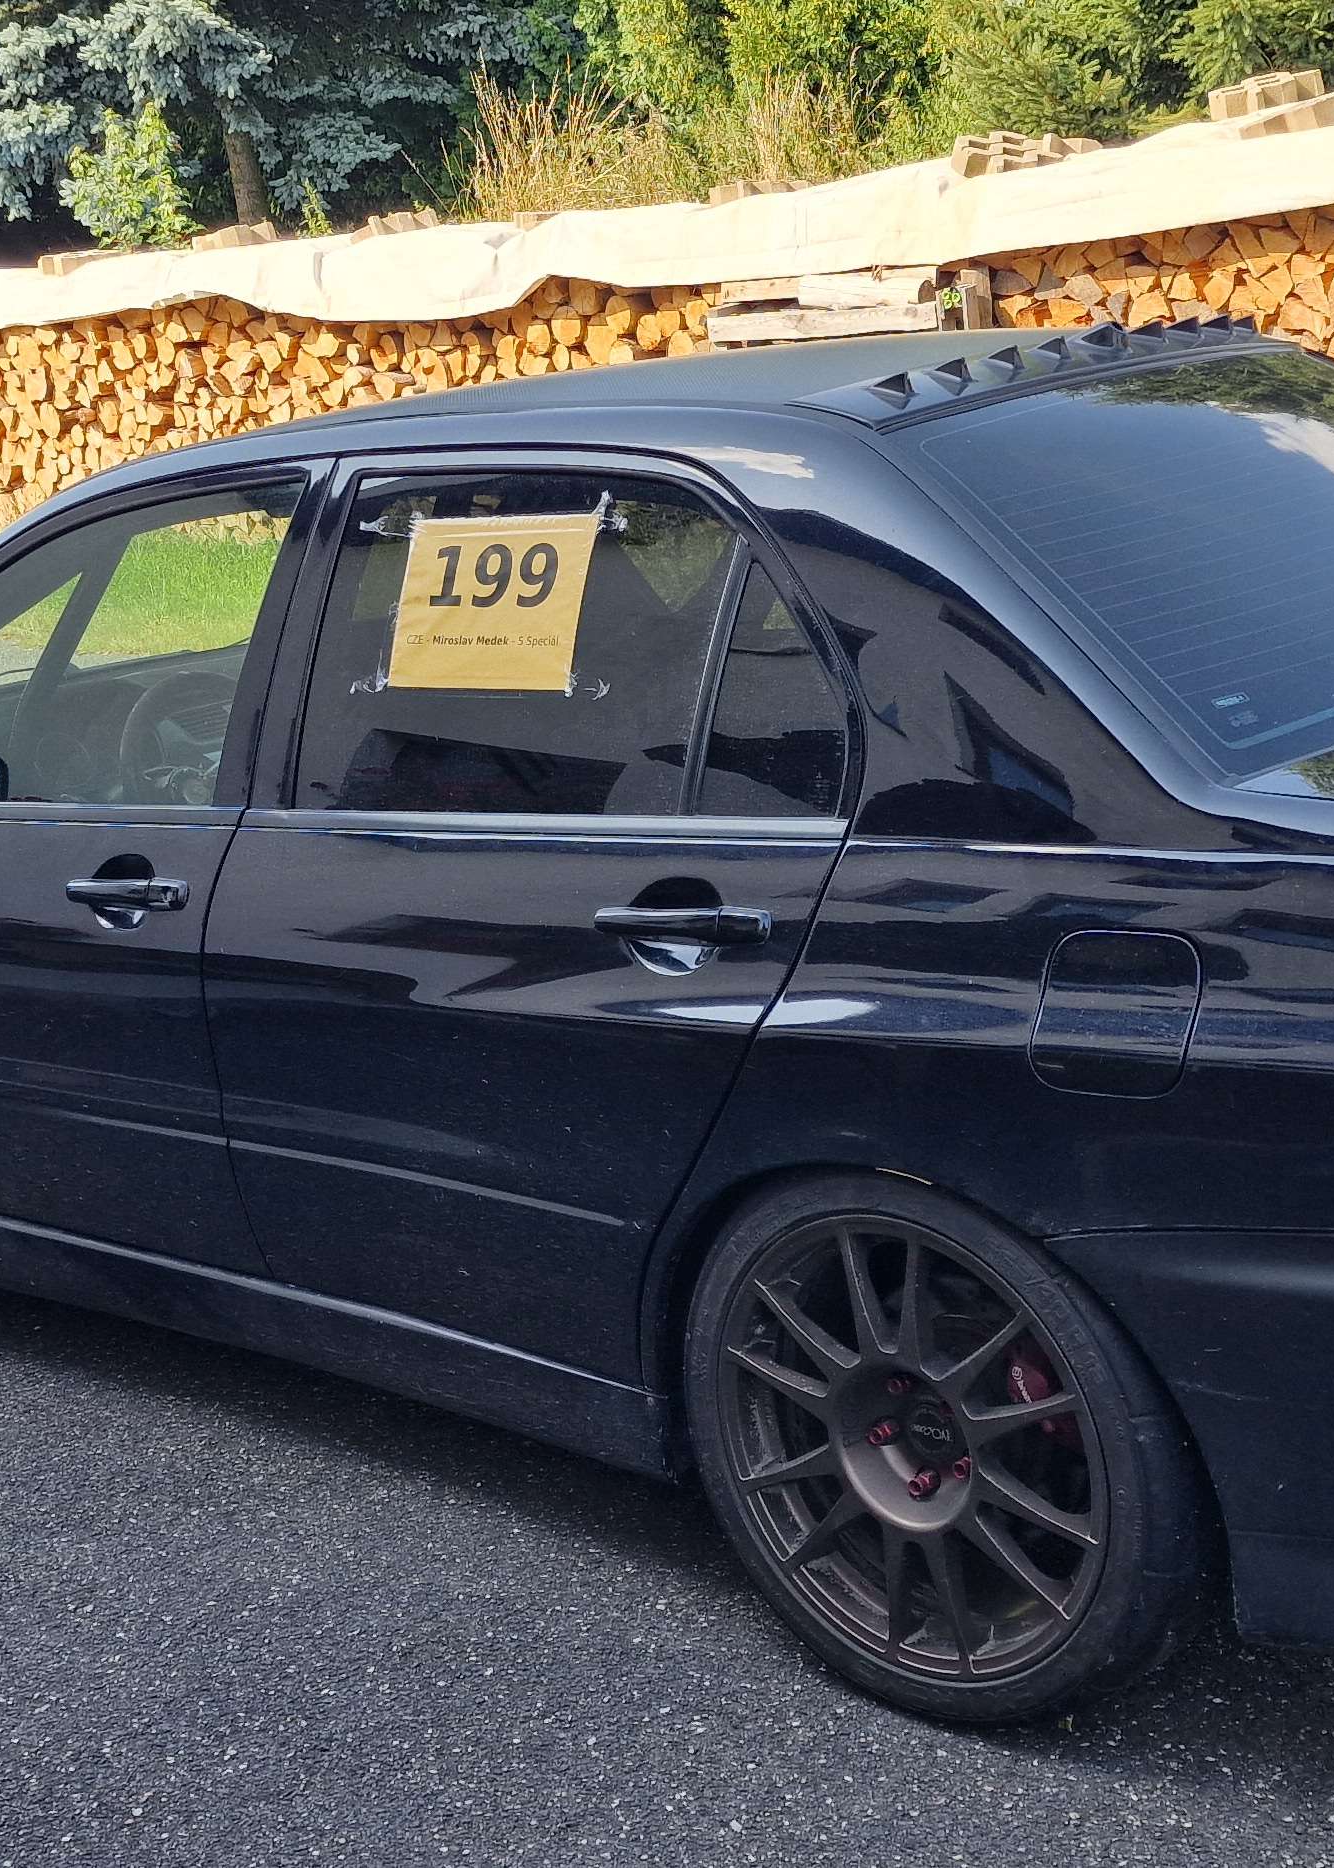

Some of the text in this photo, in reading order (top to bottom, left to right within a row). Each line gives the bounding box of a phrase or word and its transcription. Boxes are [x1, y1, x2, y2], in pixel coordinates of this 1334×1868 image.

[429, 542, 559, 608] 199
[432, 634, 474, 646] Miroslav
[476, 635, 509, 646] Medek
